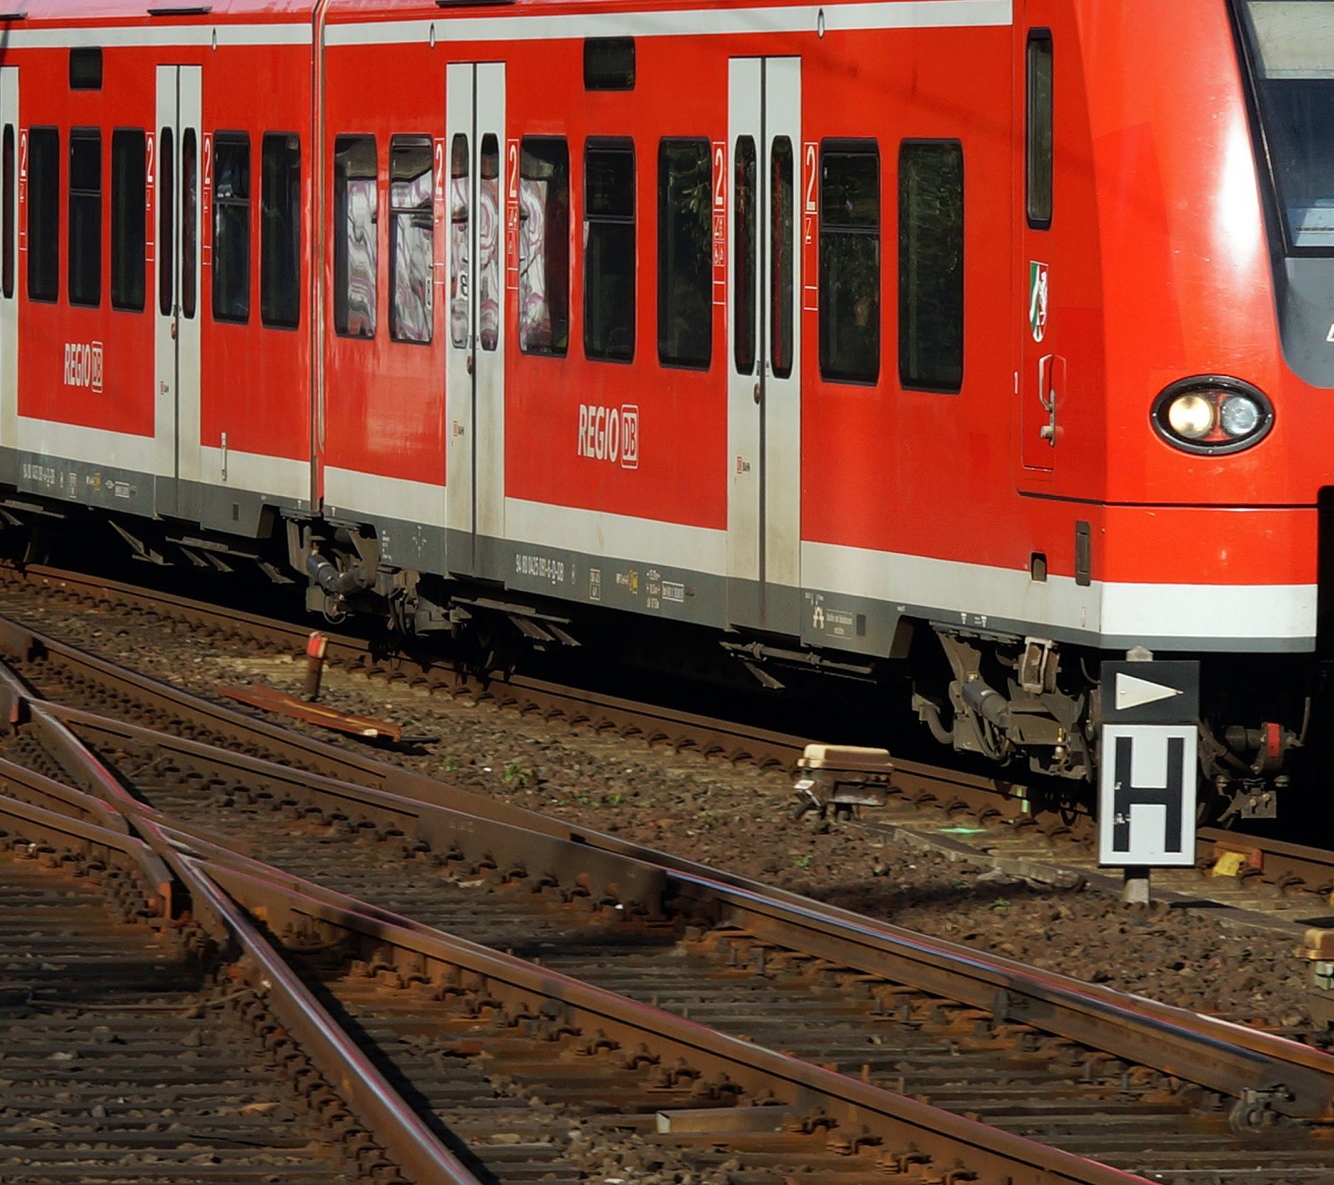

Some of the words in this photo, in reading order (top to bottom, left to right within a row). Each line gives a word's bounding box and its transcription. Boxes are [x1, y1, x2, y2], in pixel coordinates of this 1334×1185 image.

[436, 143, 443, 195] 2
[509, 144, 517, 198] 2
[715, 148, 724, 205] 2
[806, 145, 816, 210] 2
[63, 343, 91, 387] REGIO
[577, 404, 620, 463] REGIO
[623, 414, 637, 460] DB
[1112, 735, 1185, 854] H
